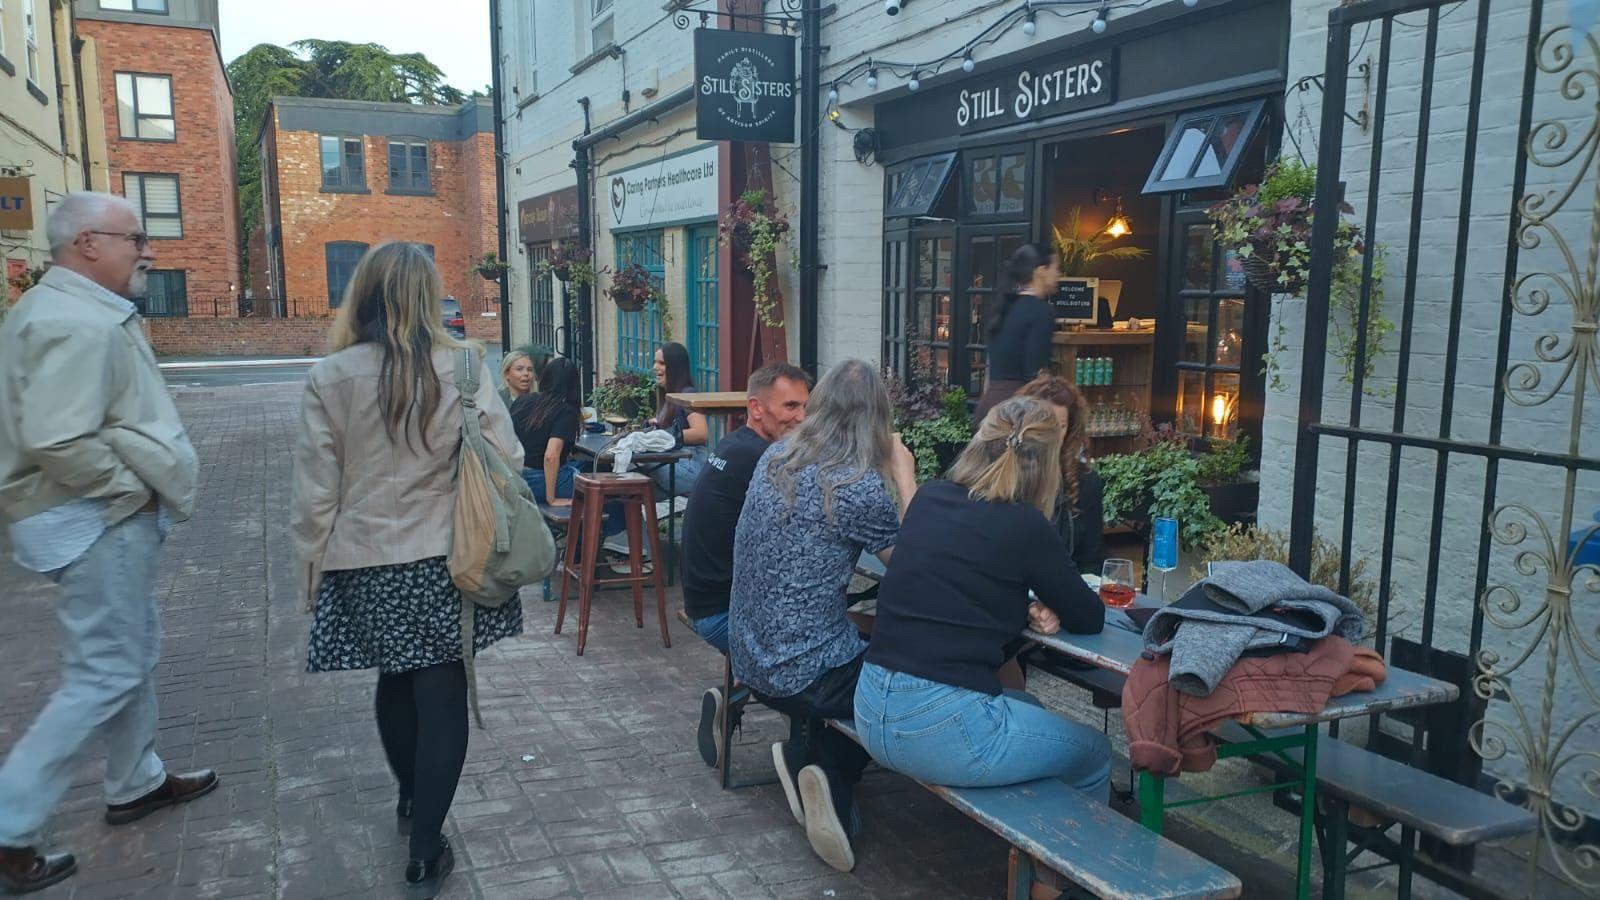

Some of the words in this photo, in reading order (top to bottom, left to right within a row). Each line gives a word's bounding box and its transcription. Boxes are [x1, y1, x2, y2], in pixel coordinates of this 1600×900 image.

[717, 48, 739, 63] FAMILY
[701, 75, 736, 95] STILL
[738, 77, 792, 100] SISTERS
[956, 87, 1005, 127] STILL
[1014, 59, 1103, 119] SISTERS
[626, 181, 644, 196] Caring
[644, 175, 666, 191] Partners
[667, 167, 702, 186] Healthcare
[703, 160, 714, 178] Ltd
